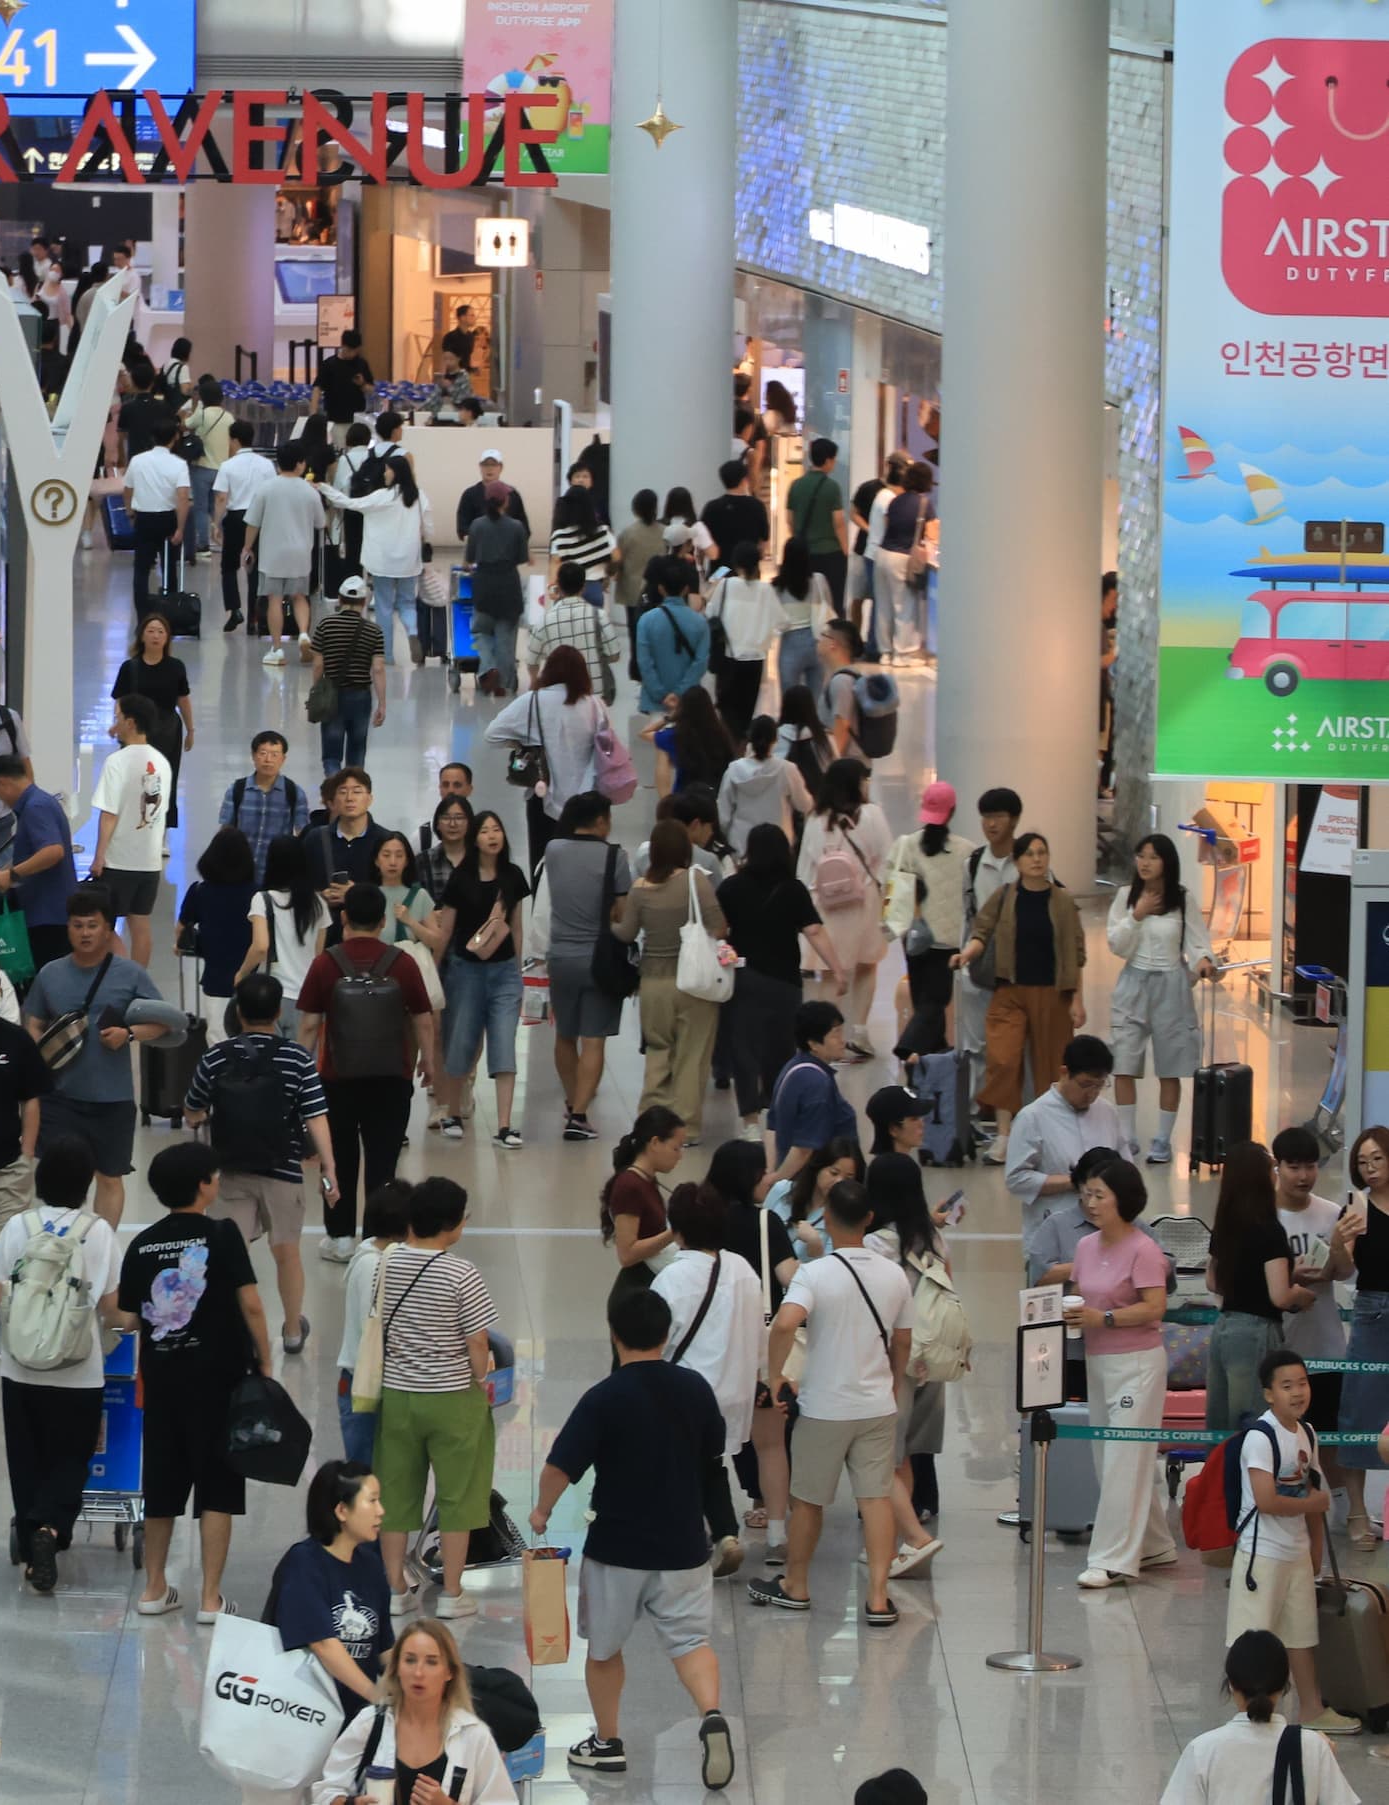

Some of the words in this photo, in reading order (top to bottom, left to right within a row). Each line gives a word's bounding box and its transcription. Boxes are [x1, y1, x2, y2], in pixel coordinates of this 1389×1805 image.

[496, 15, 554, 26] DUTYFREE
[557, 17, 582, 27] APP
[56, 86, 558, 189] AVENUE
[1220, 340, 1388, 379] 인천공항면
[1305, 1359, 1360, 1371] TARBUCKS
[1103, 1429, 1170, 1440] STARBUCKS
[1172, 1431, 1213, 1441] COFFEE
